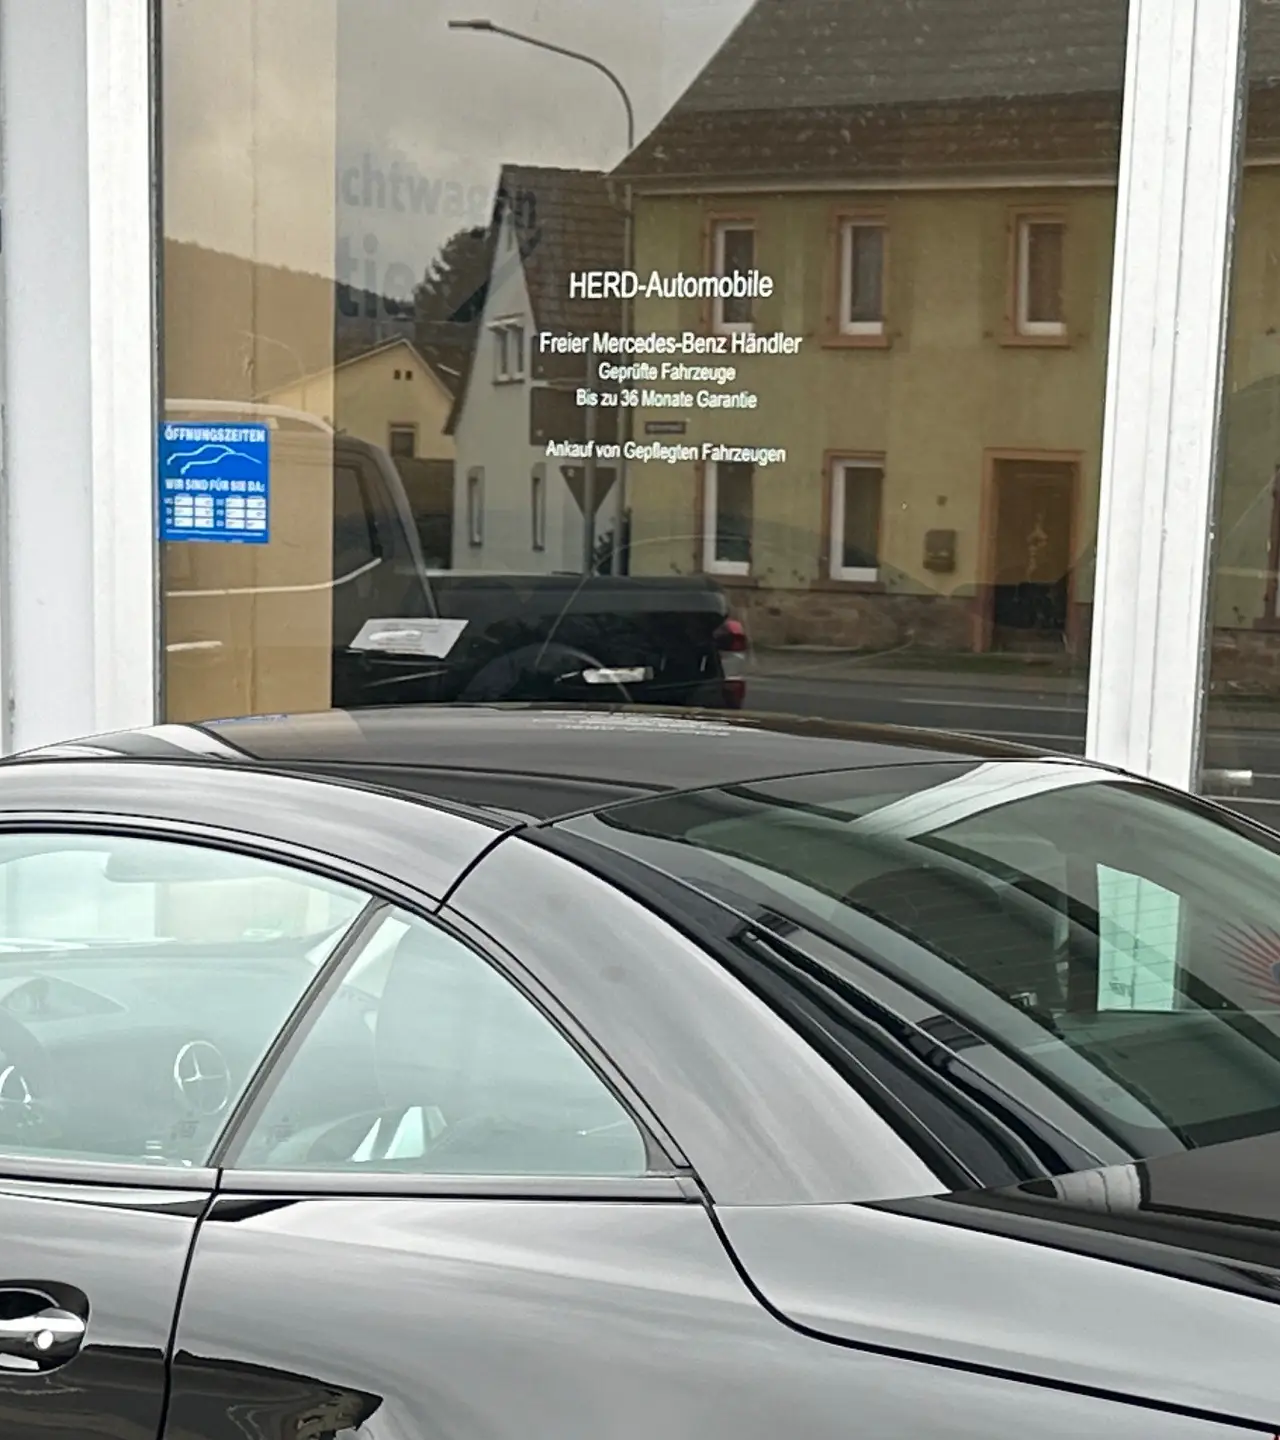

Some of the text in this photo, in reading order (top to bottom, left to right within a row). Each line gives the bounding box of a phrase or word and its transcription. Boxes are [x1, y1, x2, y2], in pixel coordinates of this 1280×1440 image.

[569, 270, 774, 299] HERD-Automobile
[539, 332, 803, 354] Freier Mercedes-Benz Händler
[598, 362, 736, 384] Geprüfte Fahrzeuge
[576, 388, 758, 408] Bis zu 36 Monate Garantie
[164, 424, 266, 442] ÖFFNUNGSZEITEN
[545, 439, 787, 466] Ankauf von Gepflegten Fahrzeugen
